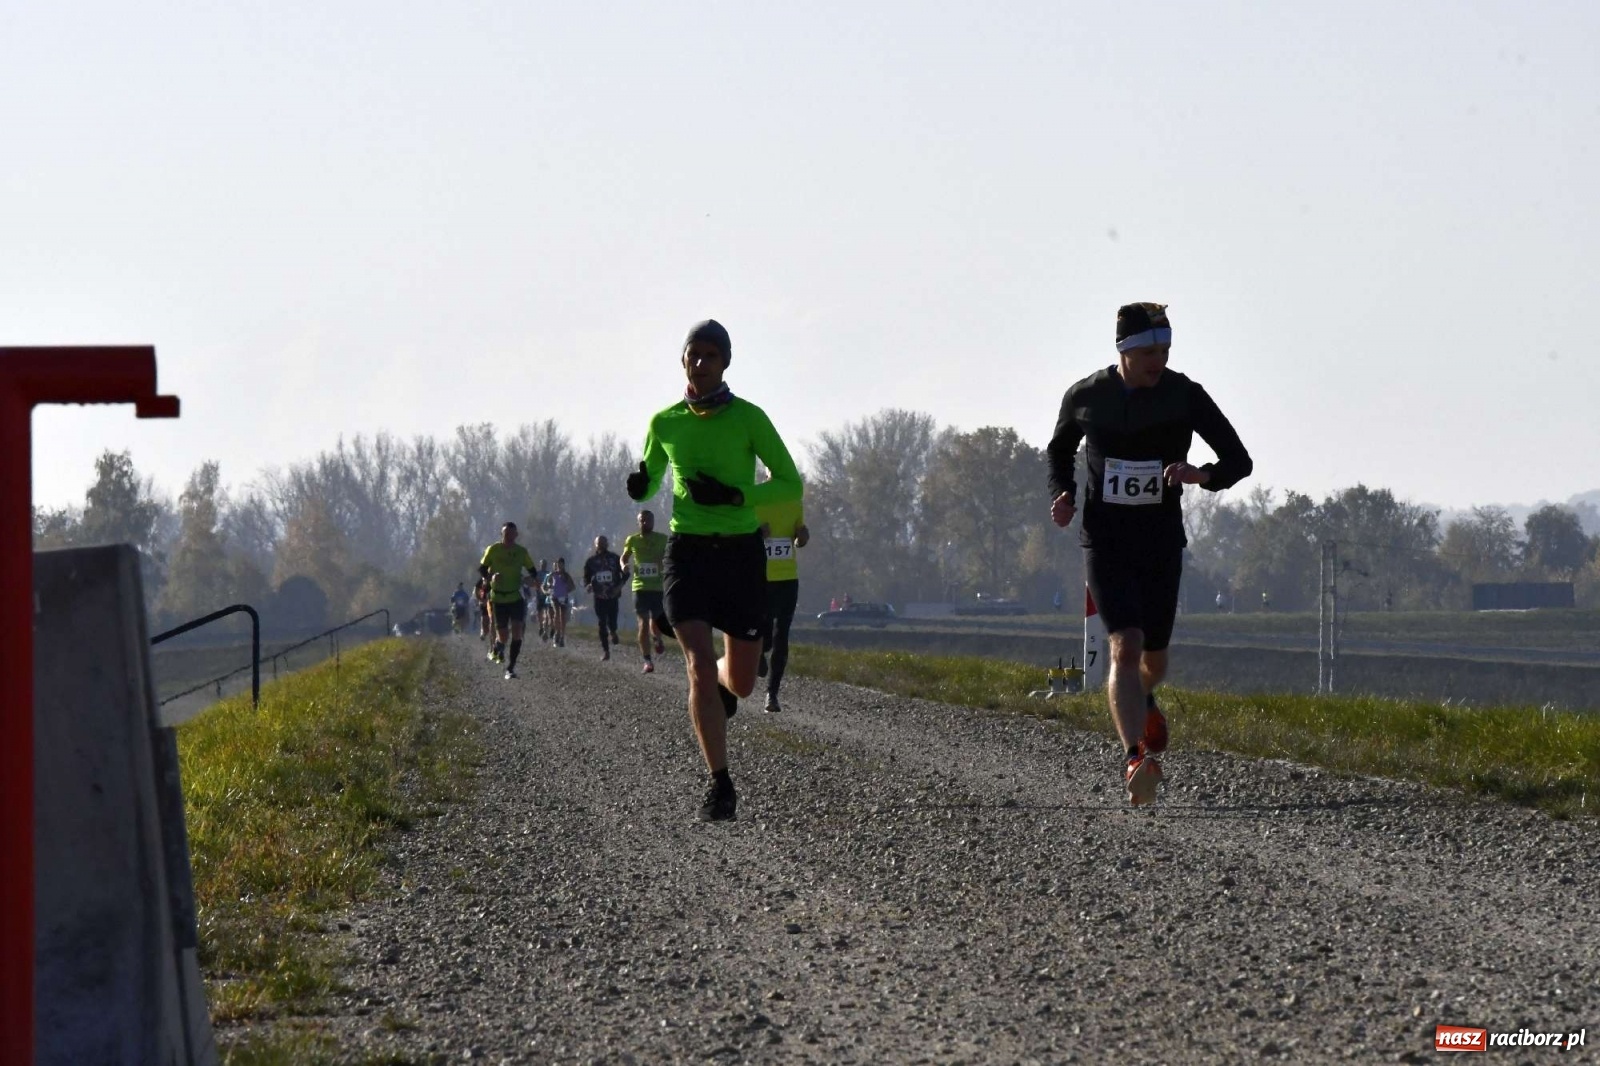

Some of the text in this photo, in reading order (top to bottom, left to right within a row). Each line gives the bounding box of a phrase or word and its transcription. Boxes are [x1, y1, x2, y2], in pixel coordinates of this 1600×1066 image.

[1108, 475, 1160, 497] 164
[765, 545, 791, 556] 157
[1088, 650, 1098, 667] 7
